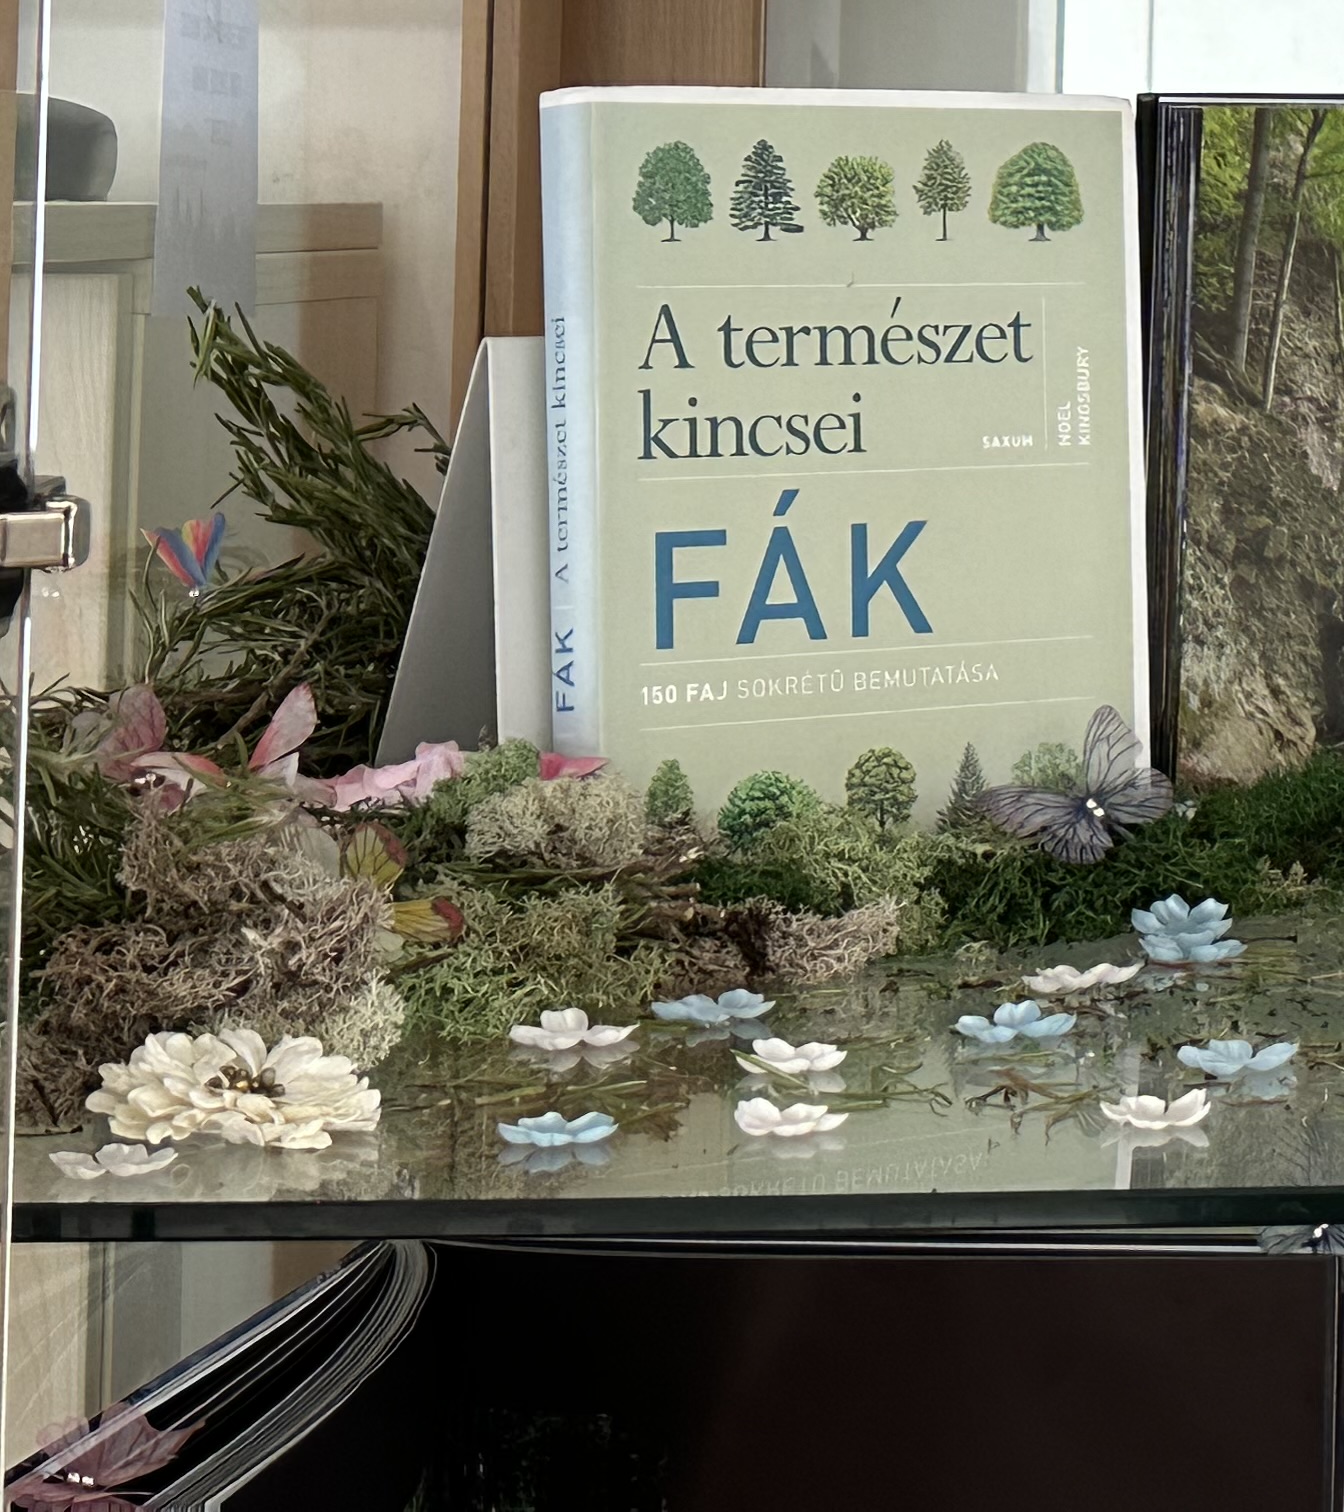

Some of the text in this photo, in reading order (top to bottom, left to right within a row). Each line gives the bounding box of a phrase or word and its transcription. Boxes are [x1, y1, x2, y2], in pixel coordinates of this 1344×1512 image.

[637, 296, 1033, 371] A természet
[637, 390, 867, 461] kincsei
[1057, 400, 1072, 447] NOEL
[1076, 346, 1091, 446] KINGSBURY
[982, 434, 1034, 449] SAXUM
[550, 316, 575, 714] FÁK A természet kincsei
[654, 489, 933, 650] FÁK
[640, 660, 1000, 706] 150 FAJ SOKRÉTŰ BEMUTATÁSA
